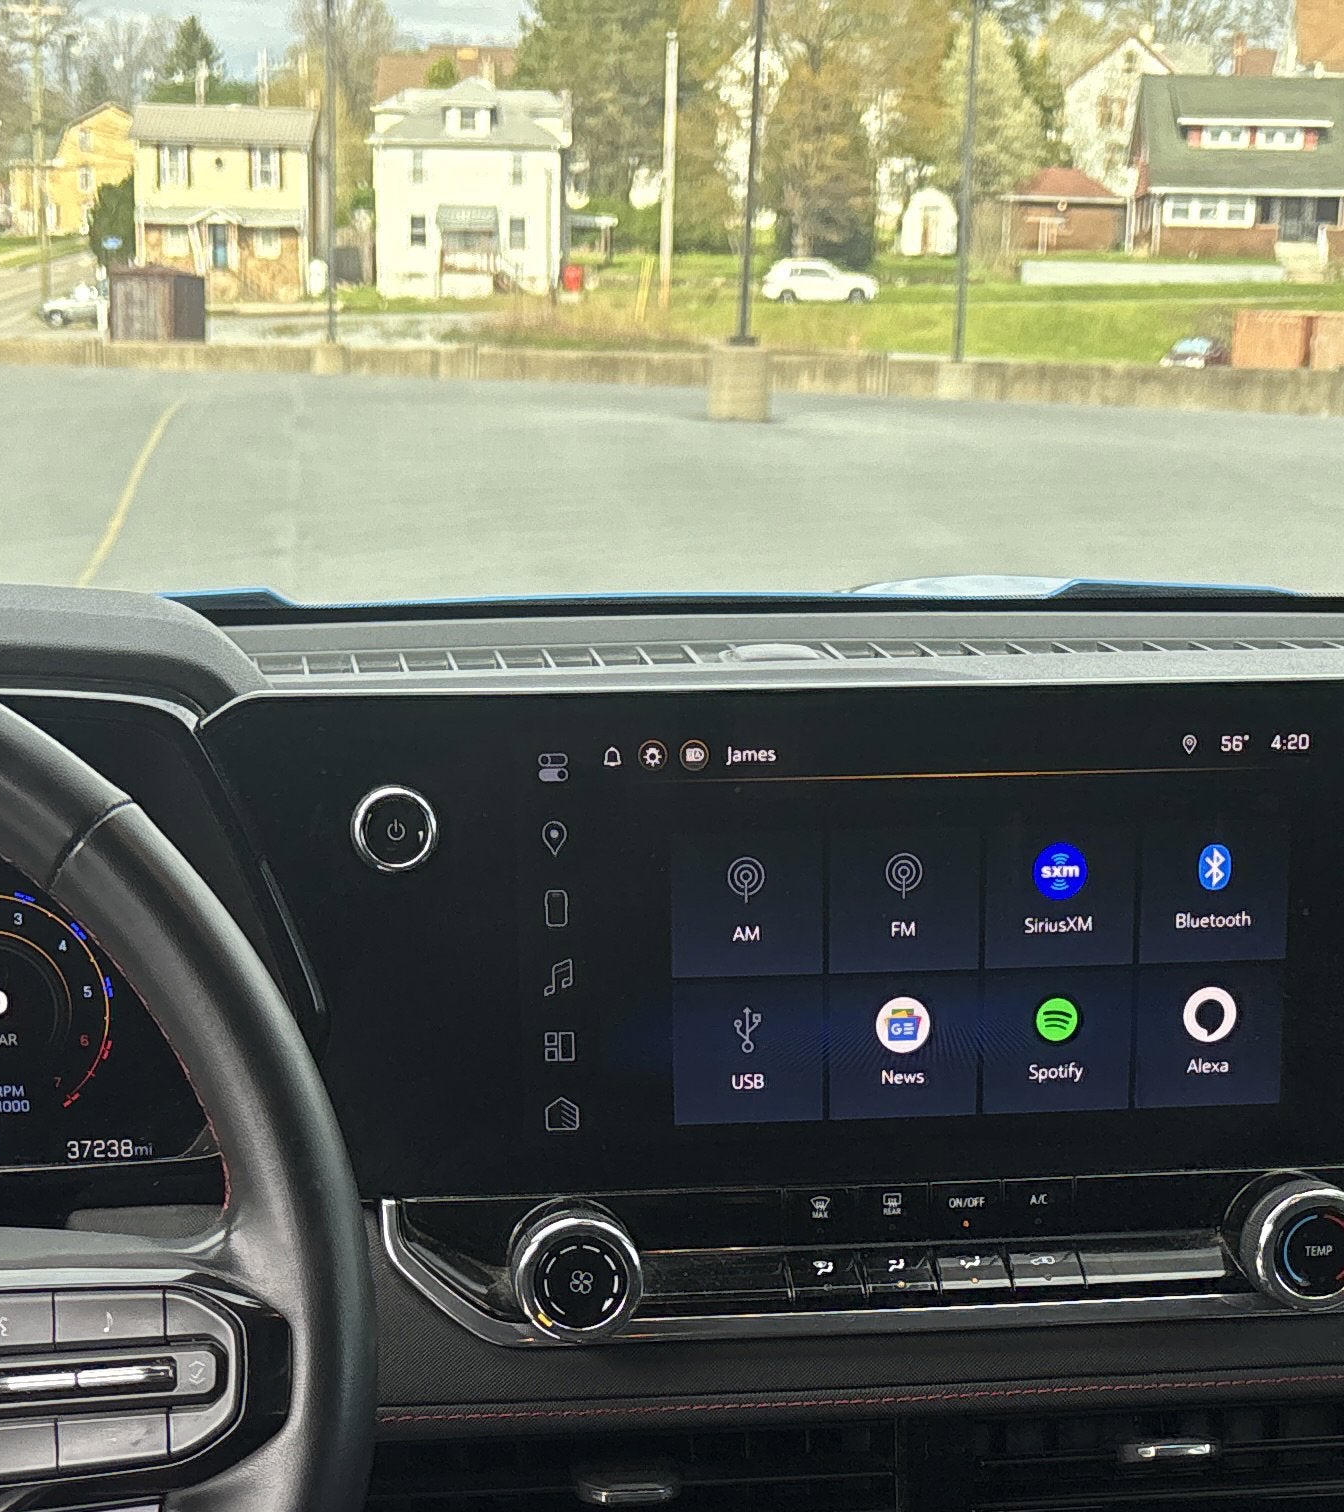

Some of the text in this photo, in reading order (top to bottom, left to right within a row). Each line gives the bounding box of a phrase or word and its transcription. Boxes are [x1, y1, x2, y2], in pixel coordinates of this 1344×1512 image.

[1220, 734, 1250, 752] 56°
[1270, 733, 1310, 751] 4:20
[725, 745, 777, 766] James
[1040, 864, 1081, 880] sxm
[13, 912, 23, 926] 3
[1024, 915, 1093, 934] SiriusXM
[1175, 910, 1252, 929] Bluetooth
[732, 925, 760, 942] AM
[891, 921, 916, 937] FM
[58, 939, 67, 951] 4
[83, 985, 93, 998] 5
[79, 1034, 90, 1047] 6
[1028, 1061, 1084, 1083] Spotify
[1186, 1057, 1229, 1074] Alexa
[53, 1076, 62, 1088] 7
[731, 1073, 765, 1090] USB
[881, 1069, 925, 1085] News
[66, 1139, 154, 1160] 37238 mi
[948, 1196, 986, 1209] ON/OFF
[1029, 1193, 1048, 1205] A/C
[811, 1210, 831, 1220] MAX
[881, 1206, 903, 1217] REAR
[1304, 1244, 1333, 1257] TEMP
